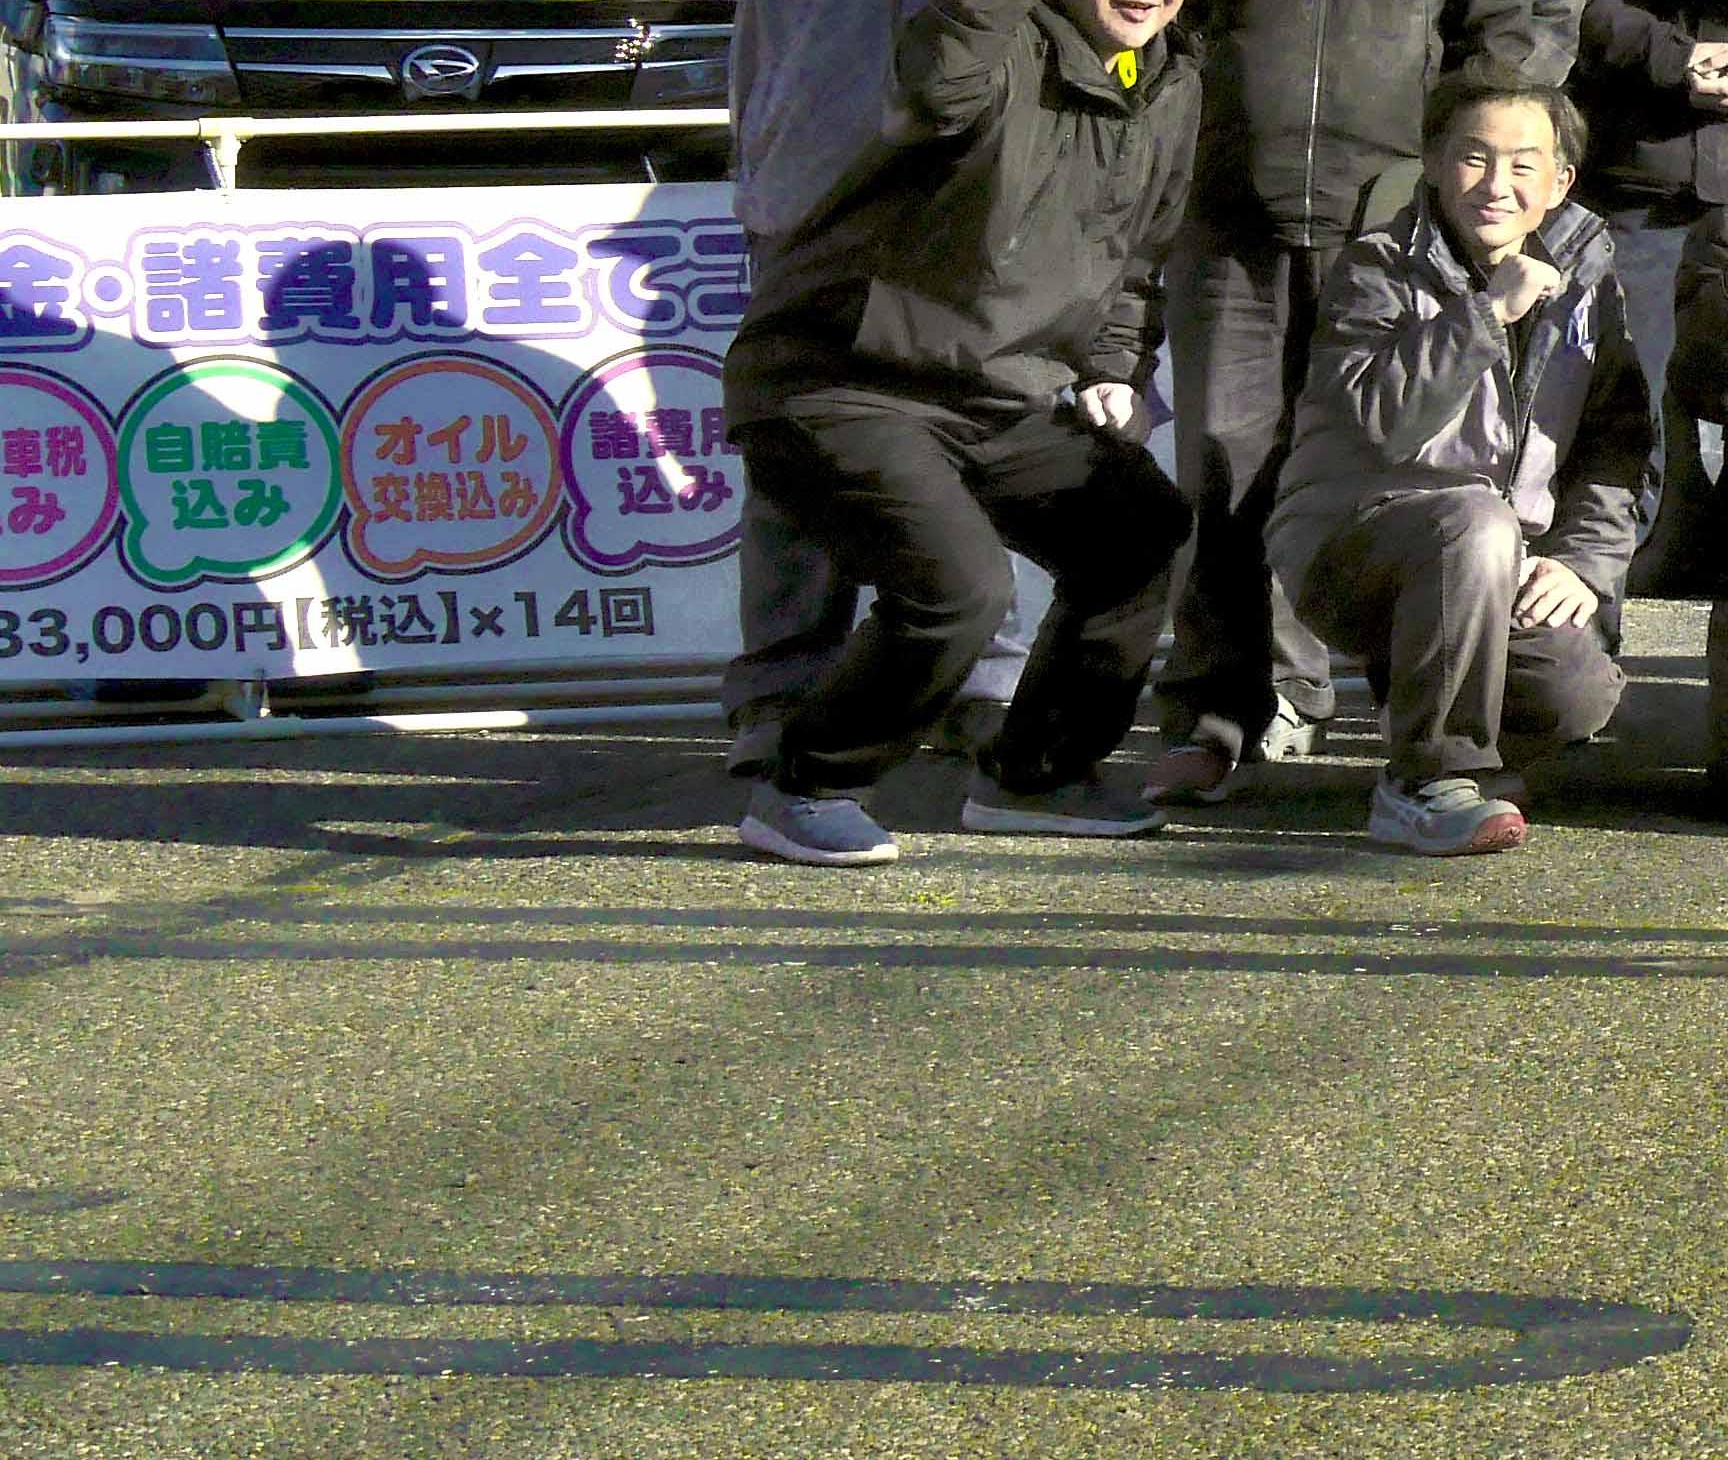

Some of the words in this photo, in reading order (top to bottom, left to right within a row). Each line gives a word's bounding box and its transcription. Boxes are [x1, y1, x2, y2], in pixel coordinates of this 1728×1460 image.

[144, 419, 311, 473] 自賠責
[374, 414, 529, 464] オイル
[0, 488, 65, 535] み
[172, 478, 291, 531] 込み
[371, 472, 540, 524] 交換込み
[617, 465, 733, 517] 込み
